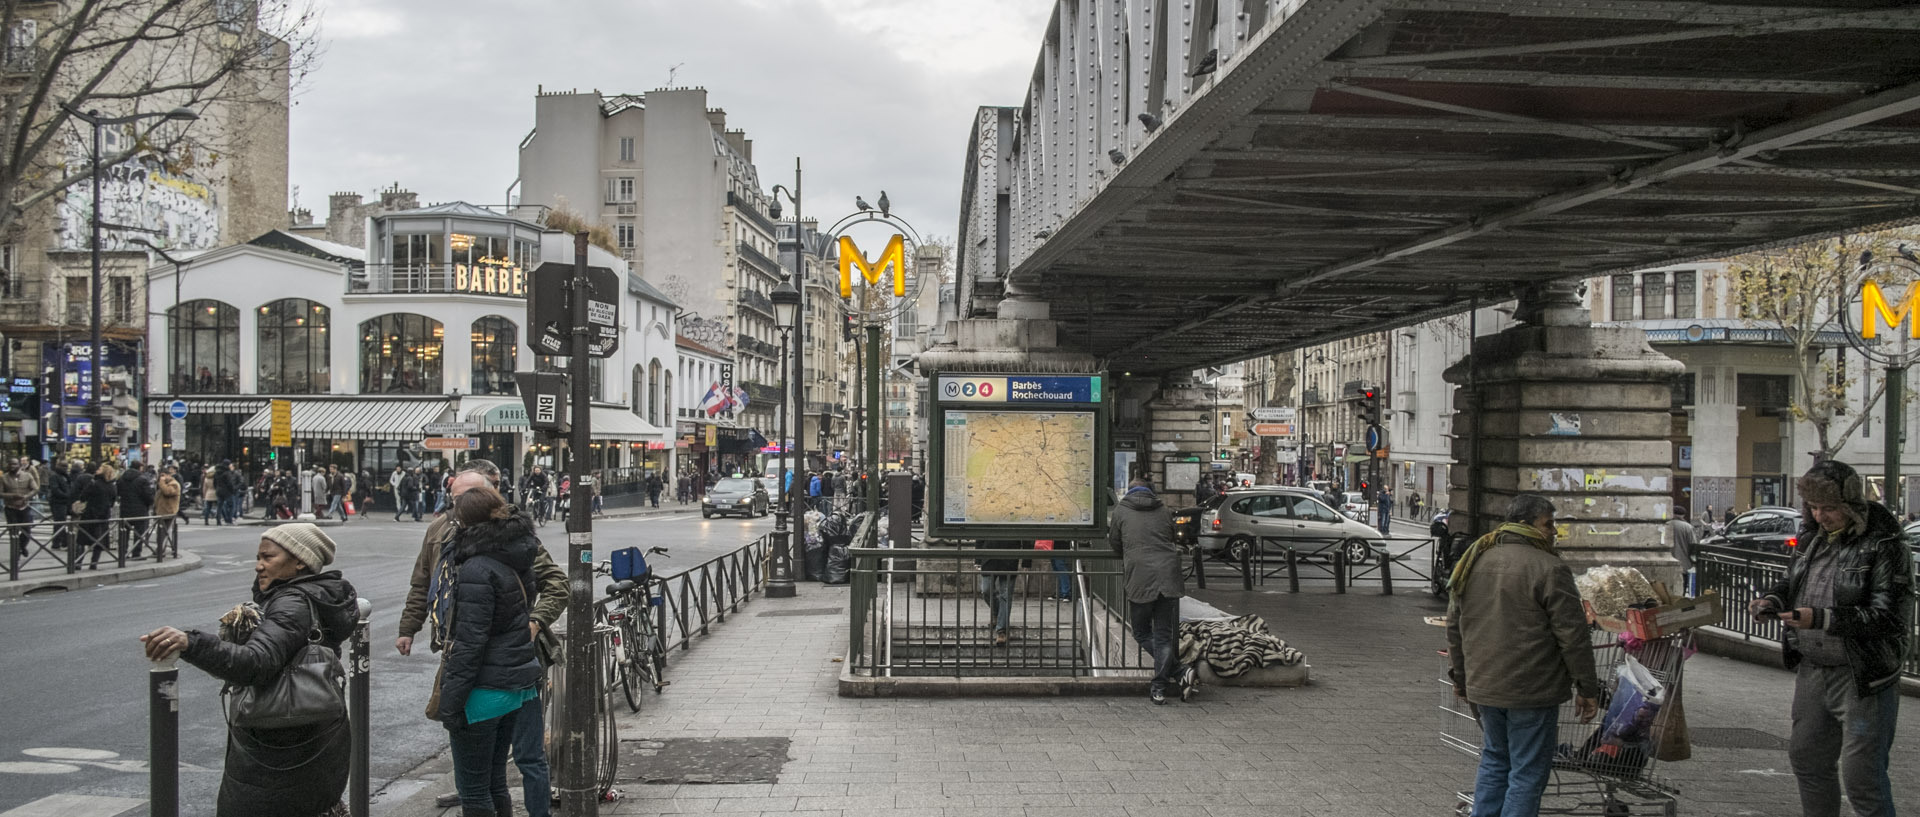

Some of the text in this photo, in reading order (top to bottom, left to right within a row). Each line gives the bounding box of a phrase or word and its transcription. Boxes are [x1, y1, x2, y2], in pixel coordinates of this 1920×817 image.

[839, 234, 905, 298] M
[594, 302, 609, 310] NON
[1861, 280, 1920, 338] M
[1012, 381, 1042, 390] Barbès
[539, 397, 553, 421] BNE
